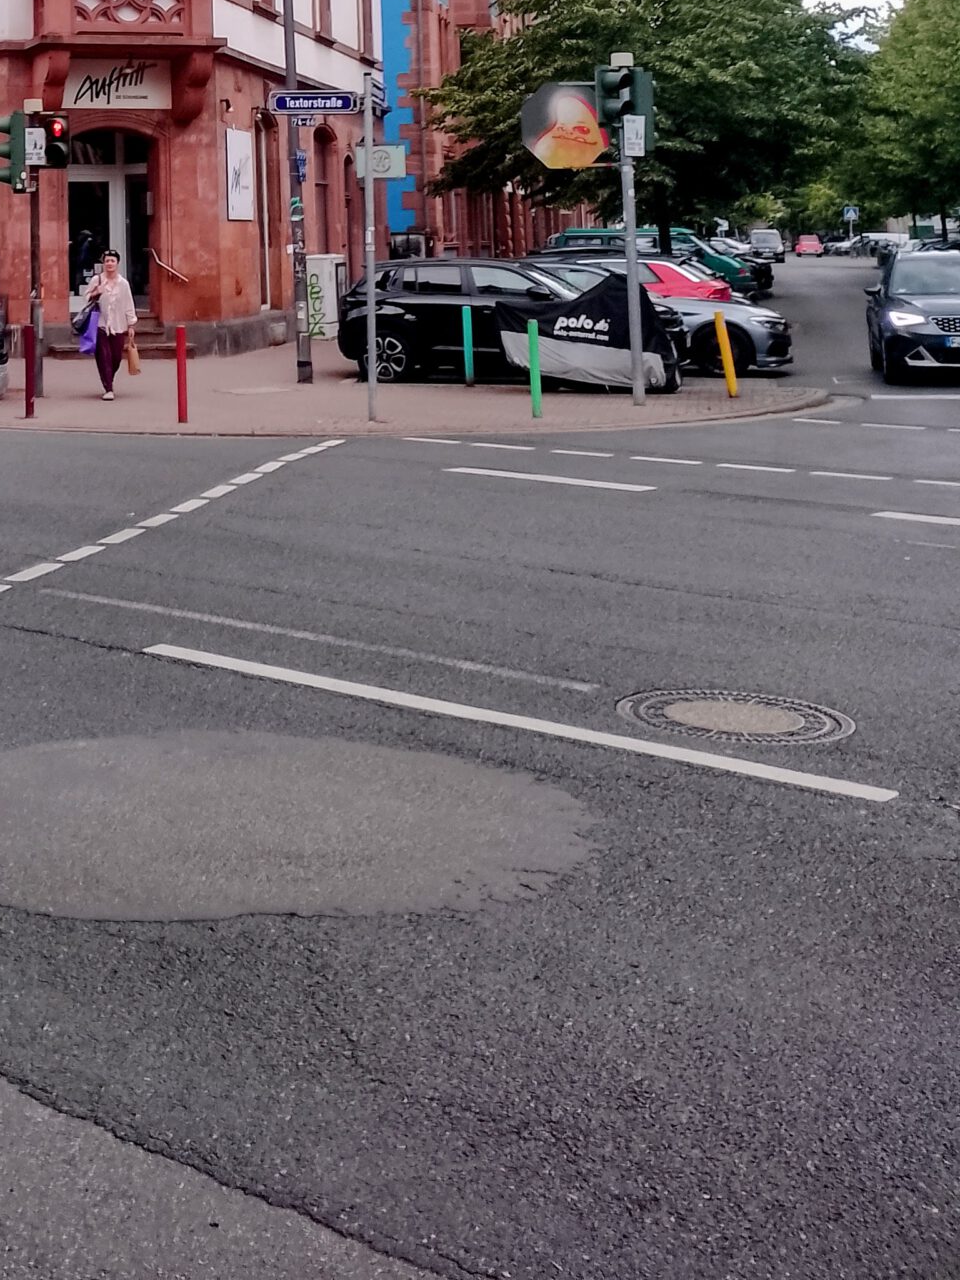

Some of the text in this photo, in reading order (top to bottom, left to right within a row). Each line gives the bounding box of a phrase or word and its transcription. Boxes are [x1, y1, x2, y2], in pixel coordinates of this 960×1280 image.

[74, 61, 157, 105] Auftritt
[285, 97, 343, 108] Textorstraße
[554, 314, 593, 330] polo
